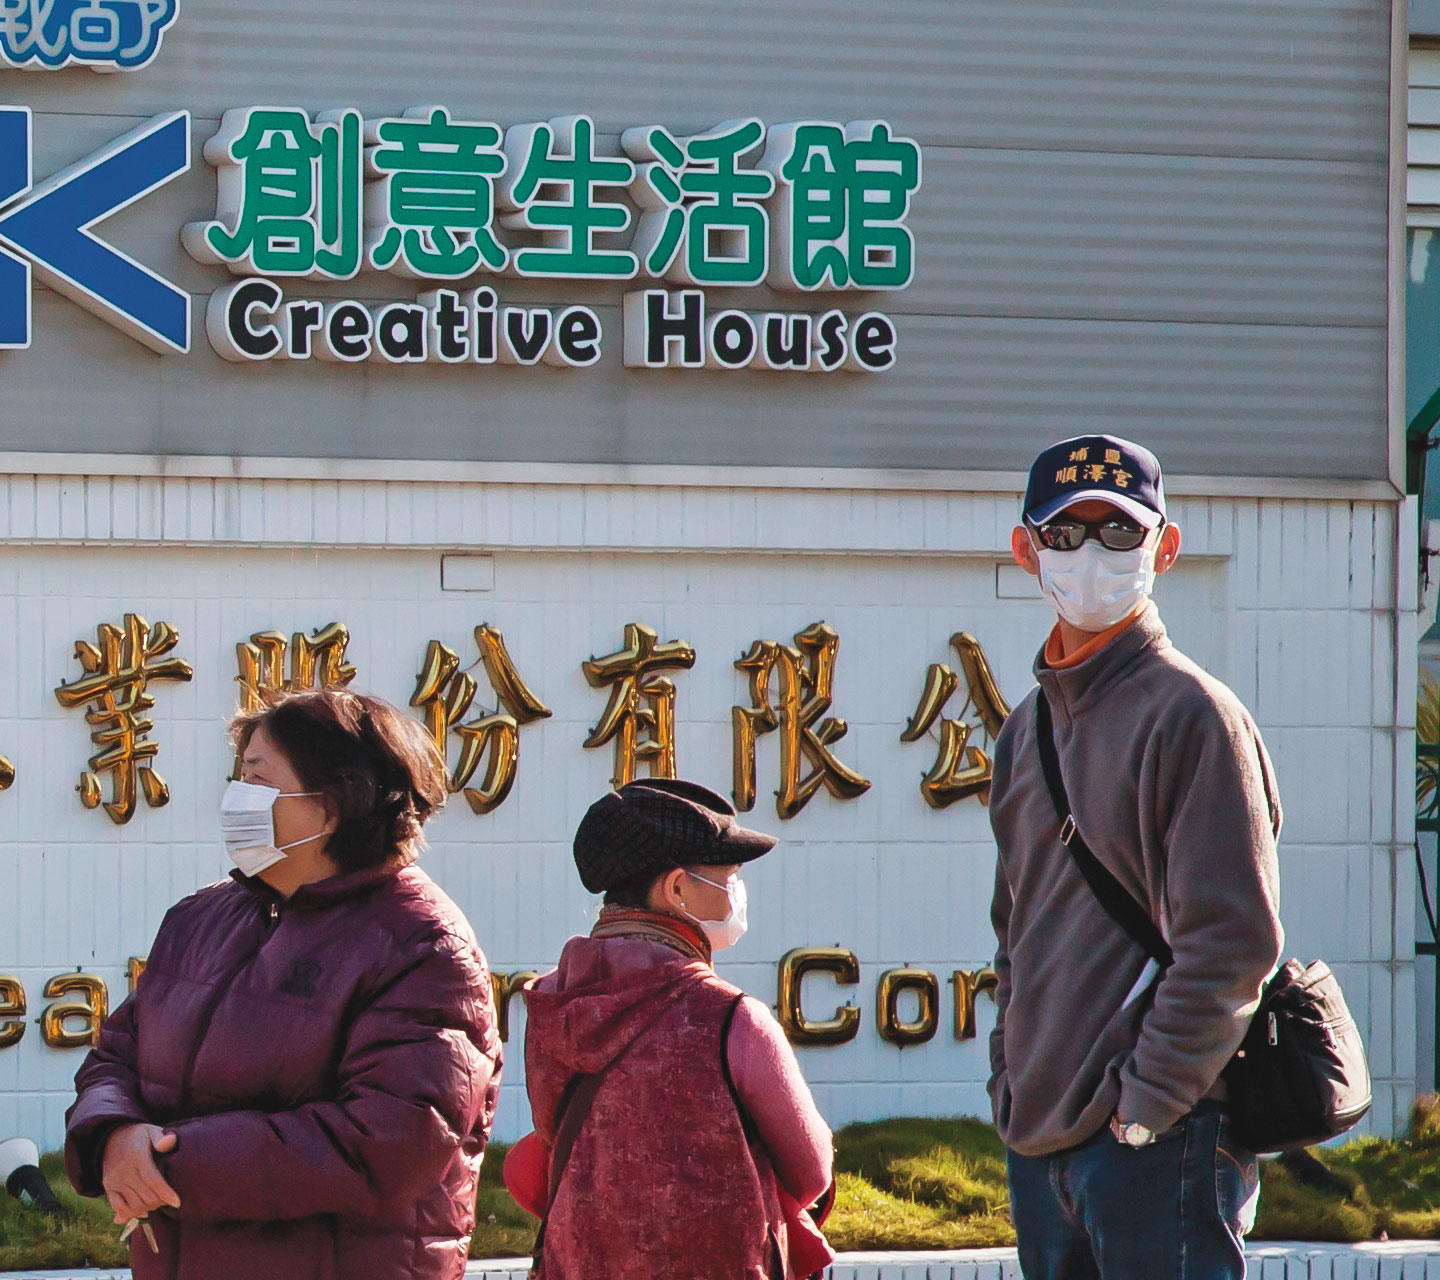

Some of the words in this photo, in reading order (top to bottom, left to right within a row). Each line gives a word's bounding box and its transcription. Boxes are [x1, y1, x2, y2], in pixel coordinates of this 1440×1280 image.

[205, 105, 922, 290] 創意生活館
[220, 278, 602, 368] Creative
[640, 288, 897, 373] House
